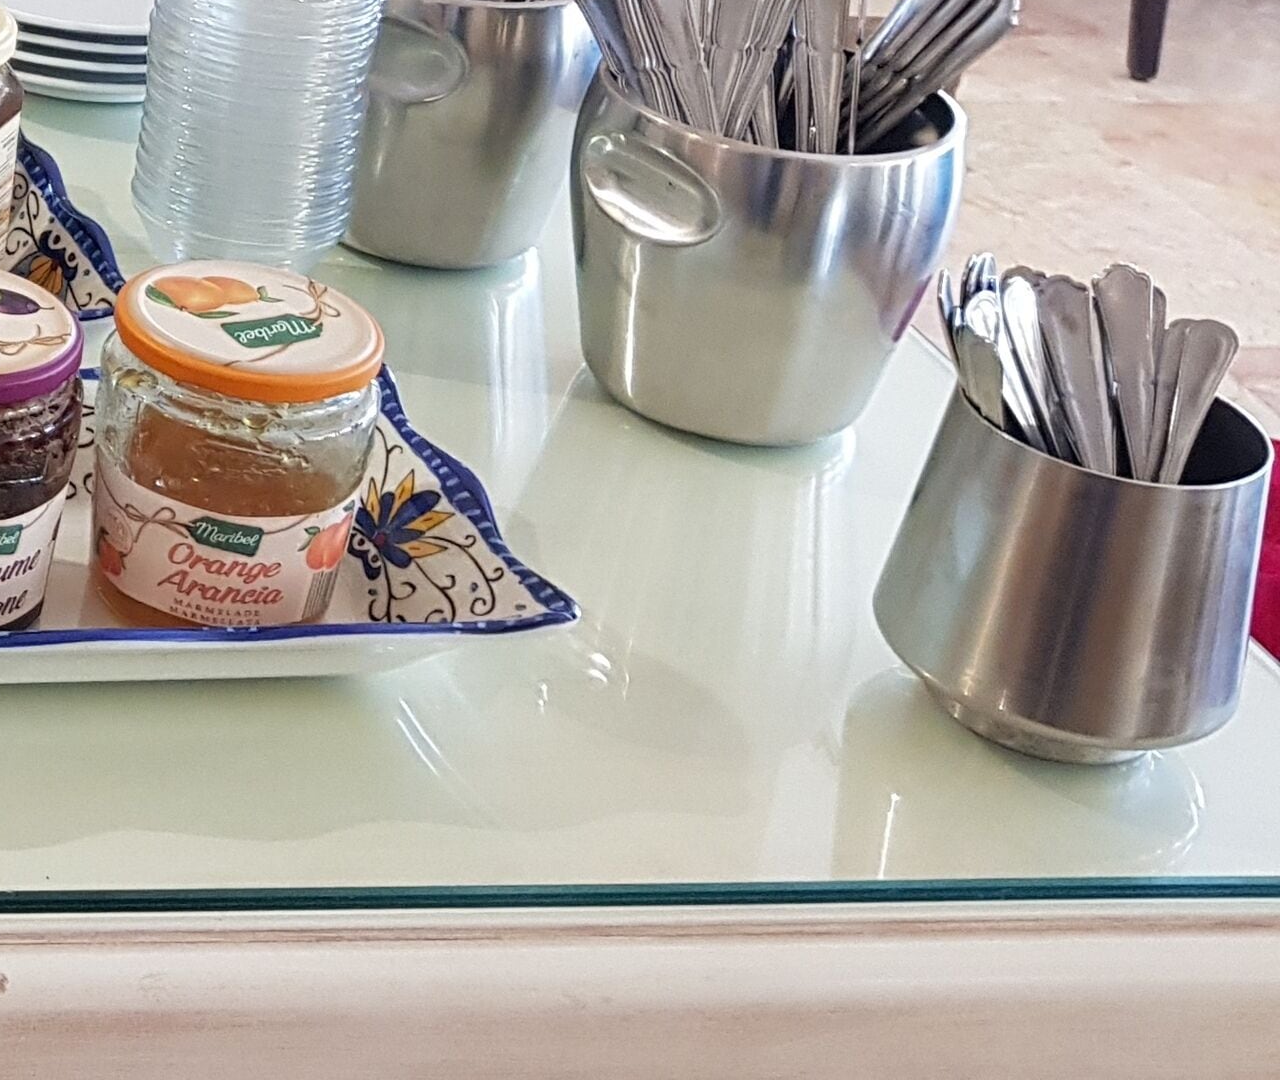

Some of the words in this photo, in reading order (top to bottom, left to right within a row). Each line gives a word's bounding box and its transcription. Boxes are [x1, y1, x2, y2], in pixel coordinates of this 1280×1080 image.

[234, 319, 317, 343] Maribel
[194, 521, 260, 546] Maribel
[167, 541, 282, 585] Orange
[156, 569, 285, 606] Arancia
[174, 597, 260, 617] MARMELADE
